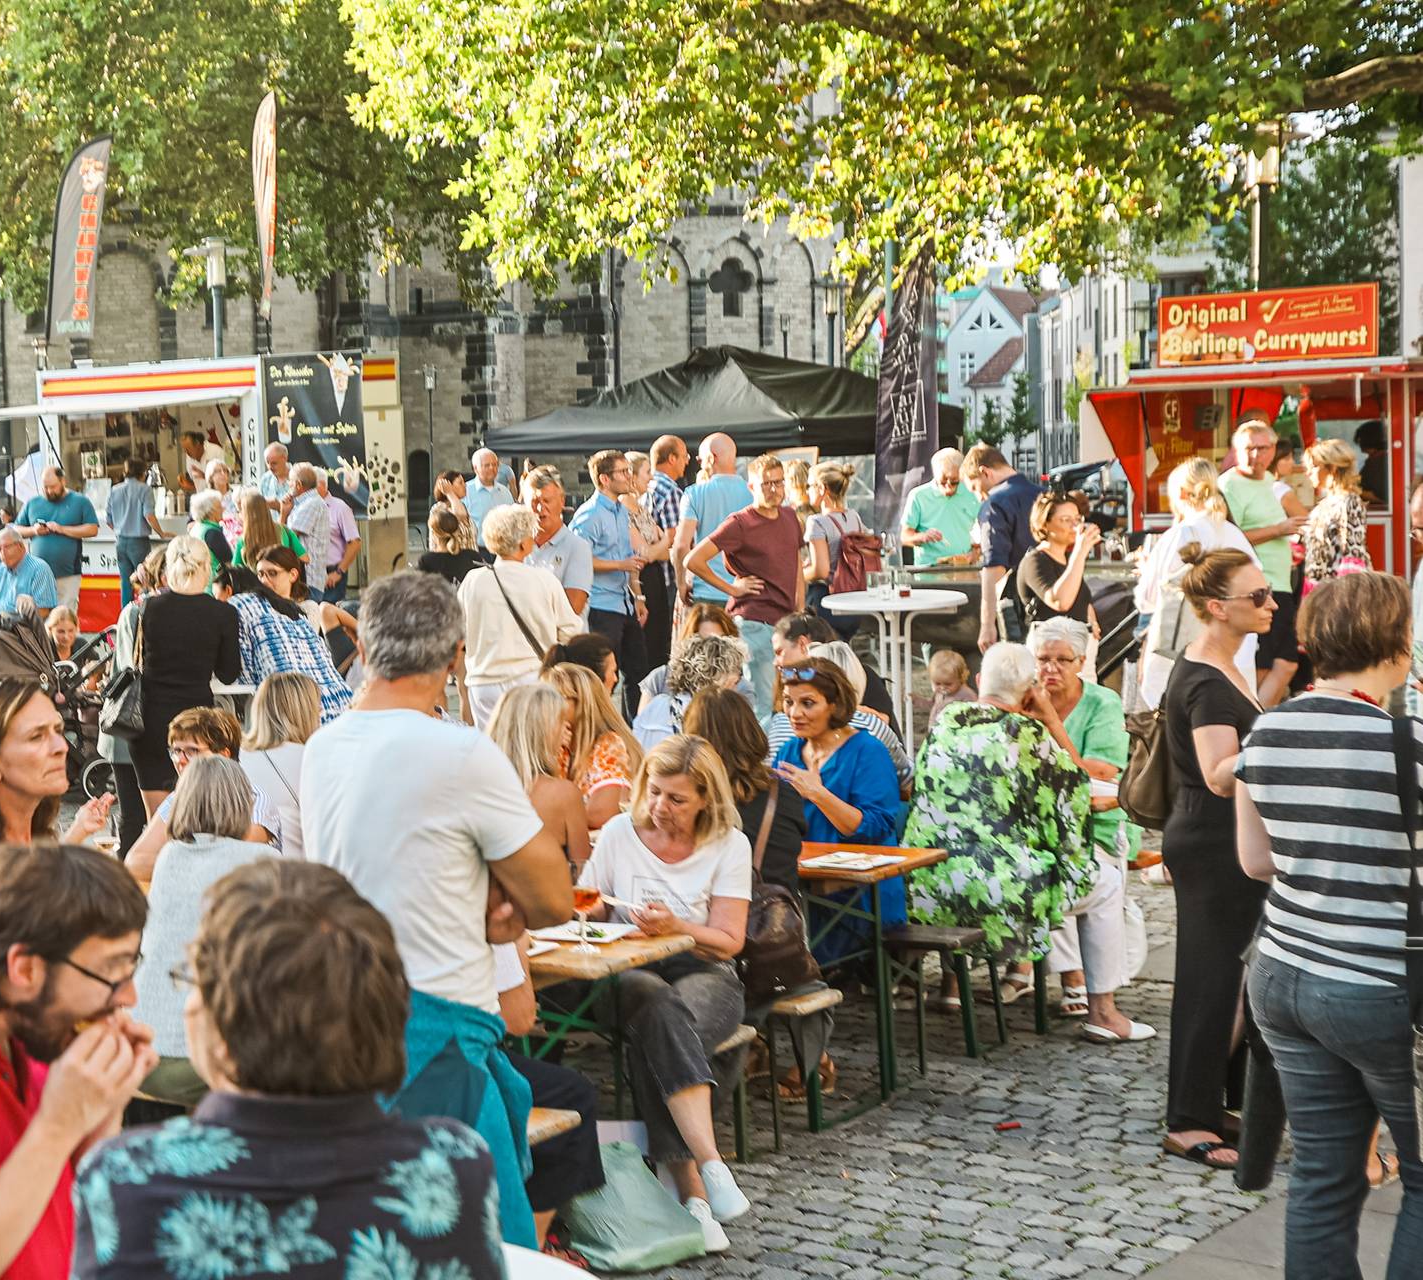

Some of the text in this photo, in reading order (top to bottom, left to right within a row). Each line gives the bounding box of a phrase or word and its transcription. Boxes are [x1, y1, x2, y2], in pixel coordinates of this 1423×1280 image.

[1168, 299, 1247, 330] Original
[56, 320, 91, 334] VEGAN
[1168, 325, 1368, 355] Berliner Currywurst
[100, 554, 118, 570] Spa
